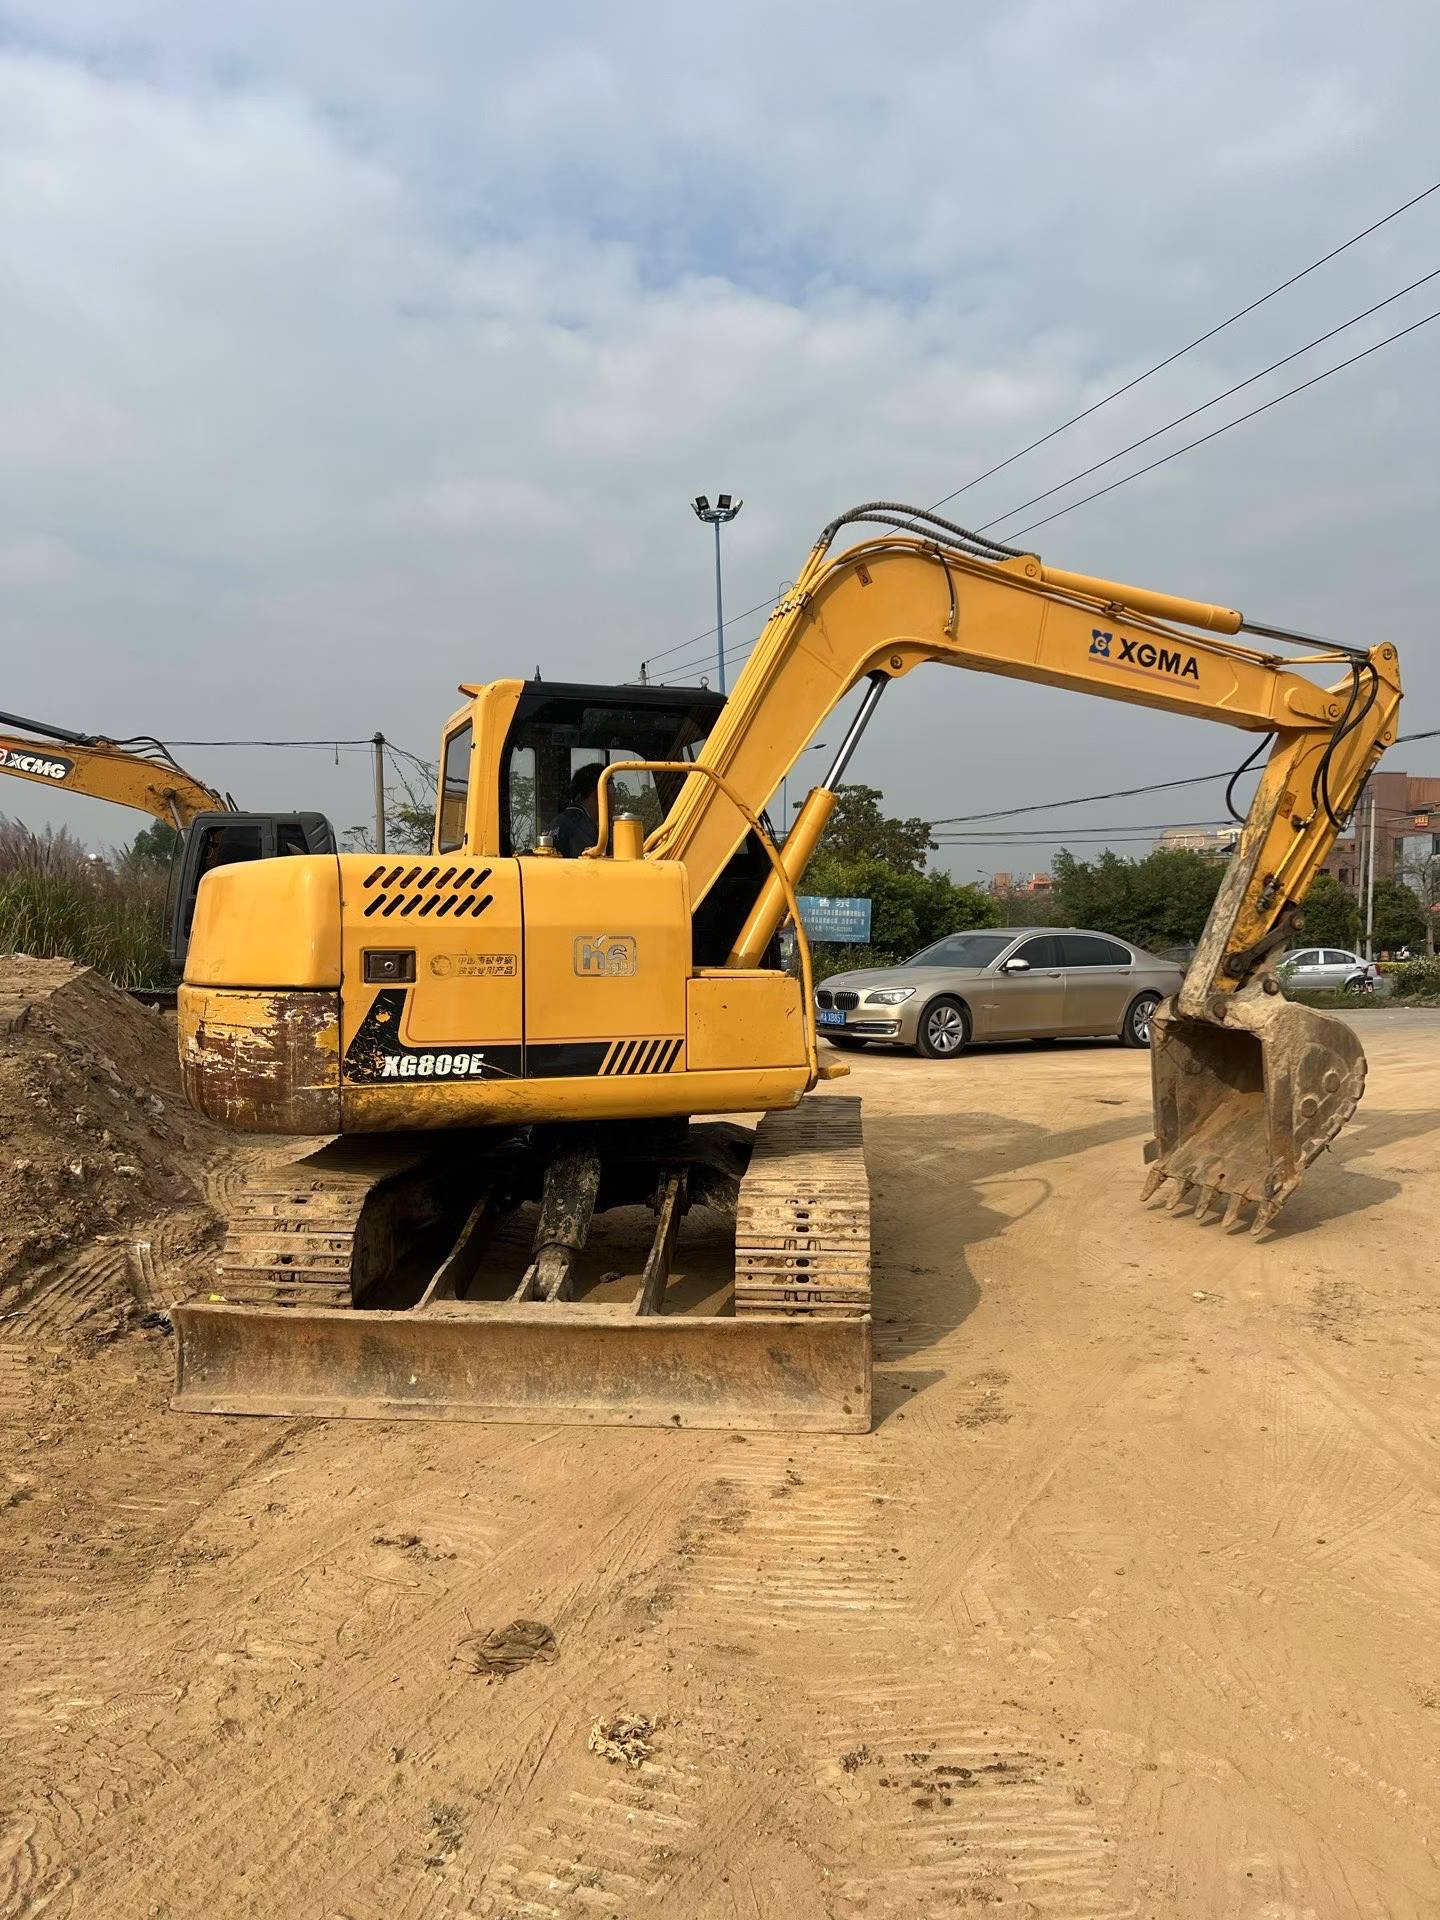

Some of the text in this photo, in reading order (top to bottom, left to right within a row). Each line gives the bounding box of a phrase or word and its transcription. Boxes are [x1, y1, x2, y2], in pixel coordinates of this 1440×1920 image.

[1117, 637, 1199, 680] XGMA
[5, 752, 66, 779] XCMG
[381, 1053, 484, 1077] XG809E
